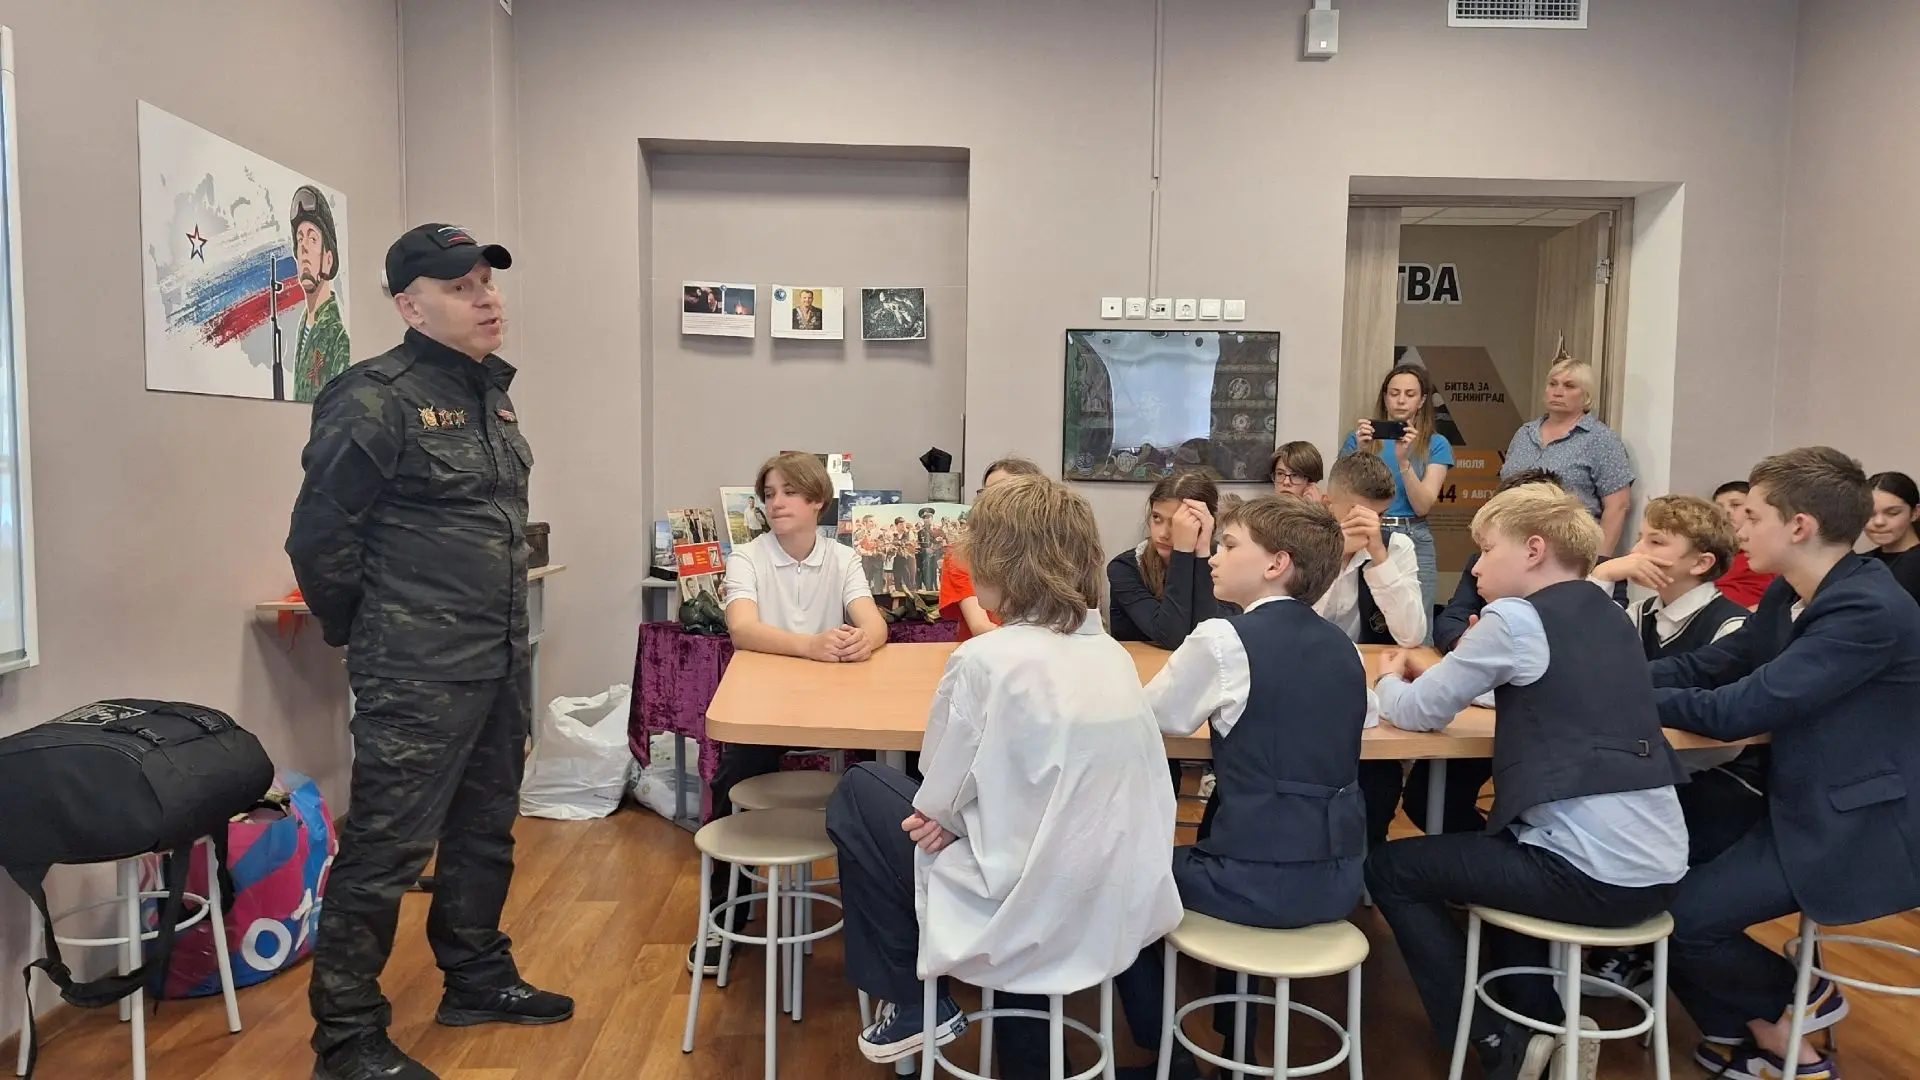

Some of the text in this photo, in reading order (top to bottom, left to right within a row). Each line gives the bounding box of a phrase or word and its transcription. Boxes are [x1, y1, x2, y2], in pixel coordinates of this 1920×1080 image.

[1444, 382, 1490, 392] БИТВА ЗА
[1451, 392, 1505, 403] ЛЕНИНГРАД
[1456, 459, 1485, 469] ИЮЛЯ
[1462, 489, 1469, 499] 9
